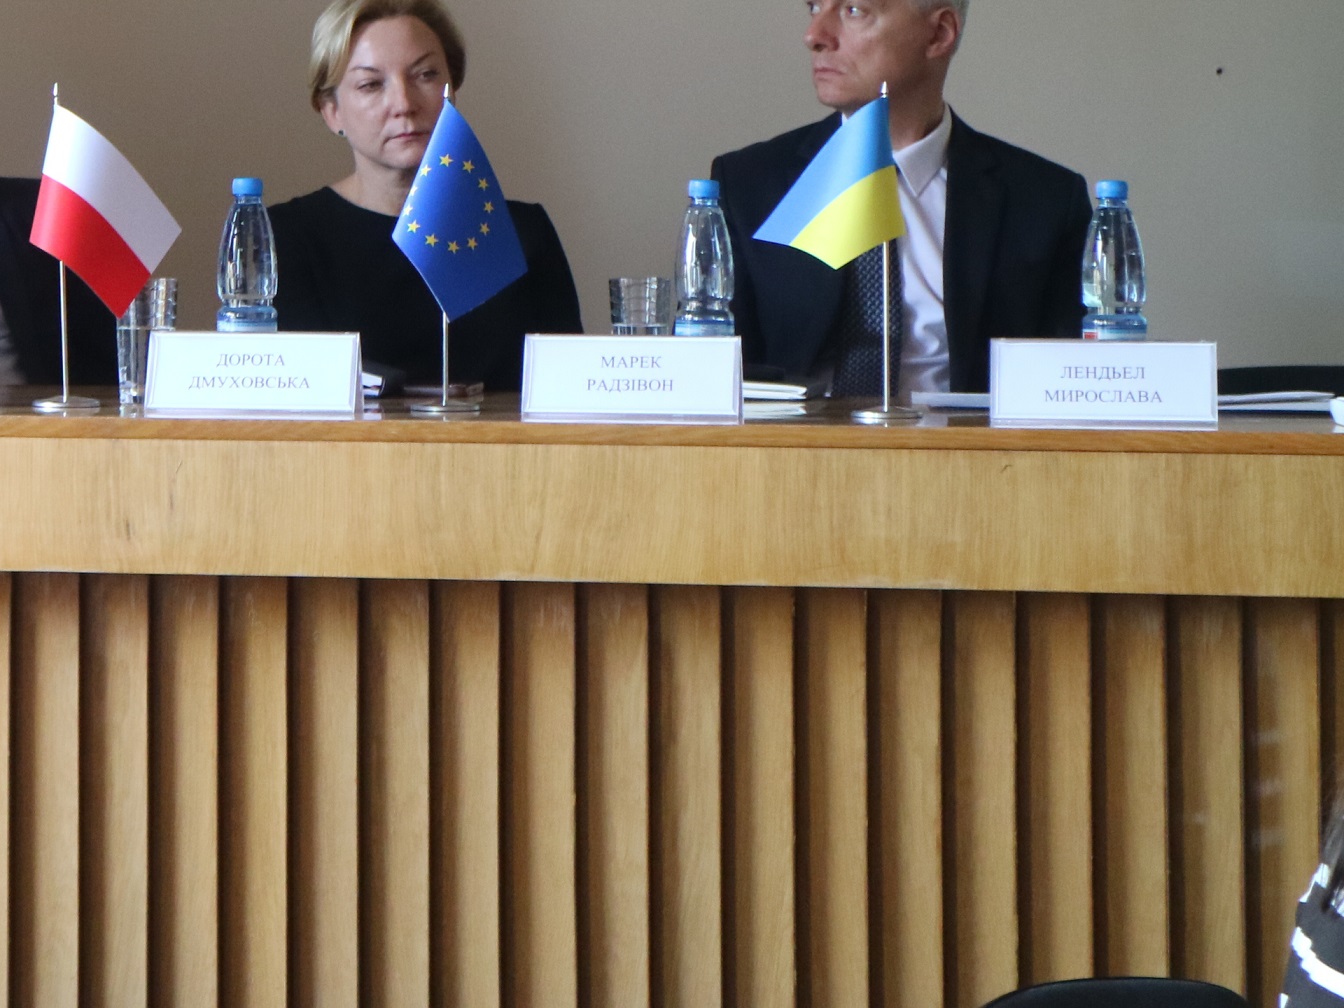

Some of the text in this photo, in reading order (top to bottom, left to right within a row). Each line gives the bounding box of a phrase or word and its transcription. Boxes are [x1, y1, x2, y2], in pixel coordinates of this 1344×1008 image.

[215, 352, 286, 368] ДОРОТА
[600, 355, 663, 369] МАРЕК
[1060, 365, 1146, 381] ЛЕНДЬЕЛ
[187, 375, 311, 390] ДМУХОВСЬКА
[586, 378, 674, 393] РАДЗІВОН
[1043, 389, 1163, 403] МИРОСЛАВА
